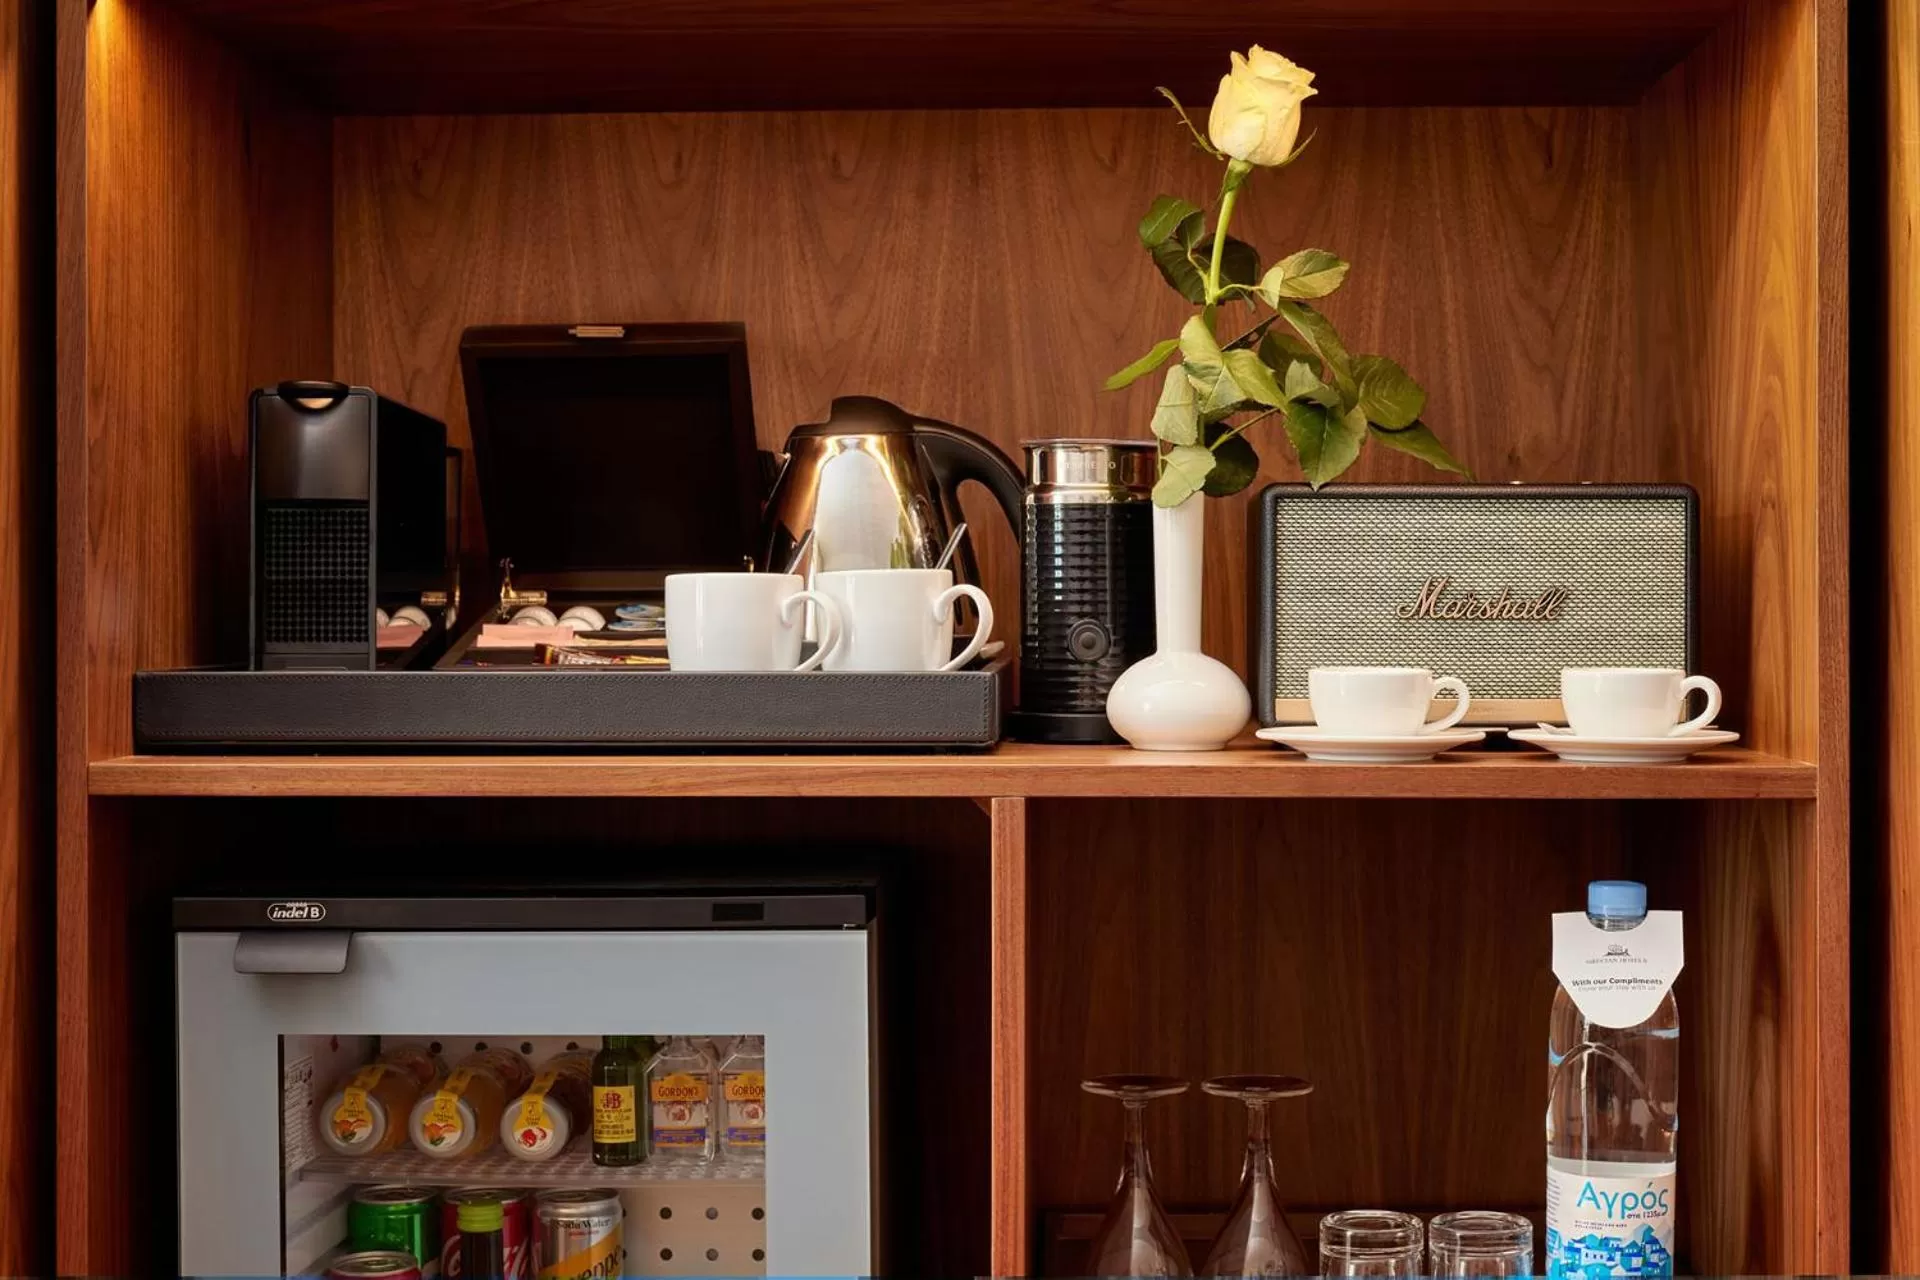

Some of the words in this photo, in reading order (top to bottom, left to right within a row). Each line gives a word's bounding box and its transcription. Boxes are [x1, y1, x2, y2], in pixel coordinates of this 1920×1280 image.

[1397, 576, 1567, 619] Marshall
[273, 906, 309, 918] indel
[310, 907, 320, 918] B
[1609, 977, 1663, 985] Compliments
[1576, 1180, 1669, 1219] Αγρός
[582, 1217, 611, 1229] Water
